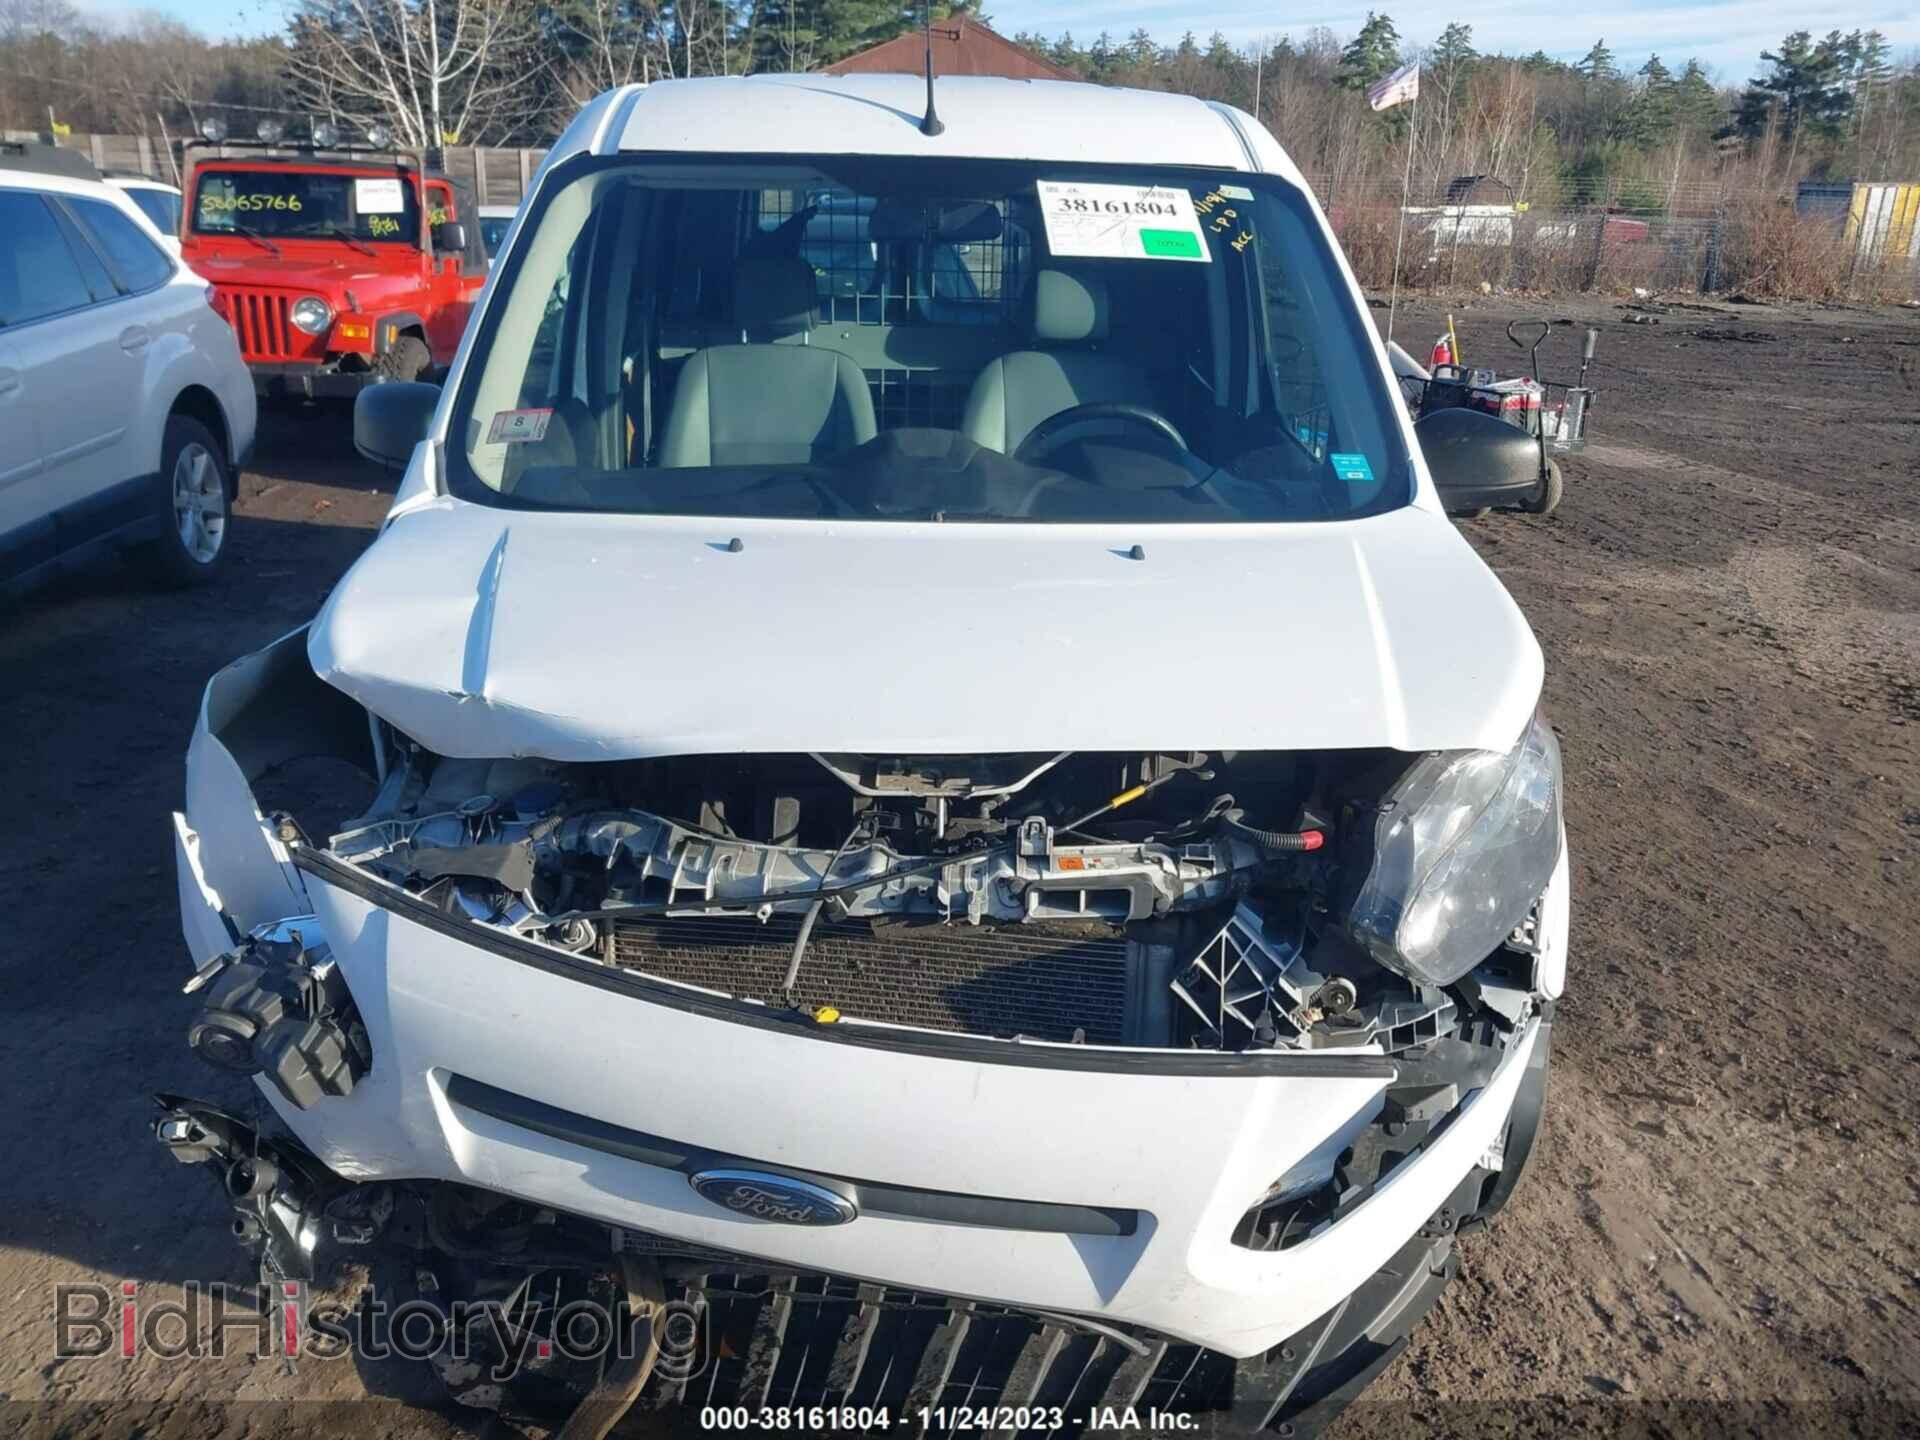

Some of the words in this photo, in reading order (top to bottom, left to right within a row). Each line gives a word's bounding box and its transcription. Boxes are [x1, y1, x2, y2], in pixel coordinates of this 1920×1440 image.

[1058, 198, 1177, 217] 38161804
[1230, 230, 1255, 252] ACC
[513, 415, 525, 427] 8
[726, 1185, 813, 1222] Ford
